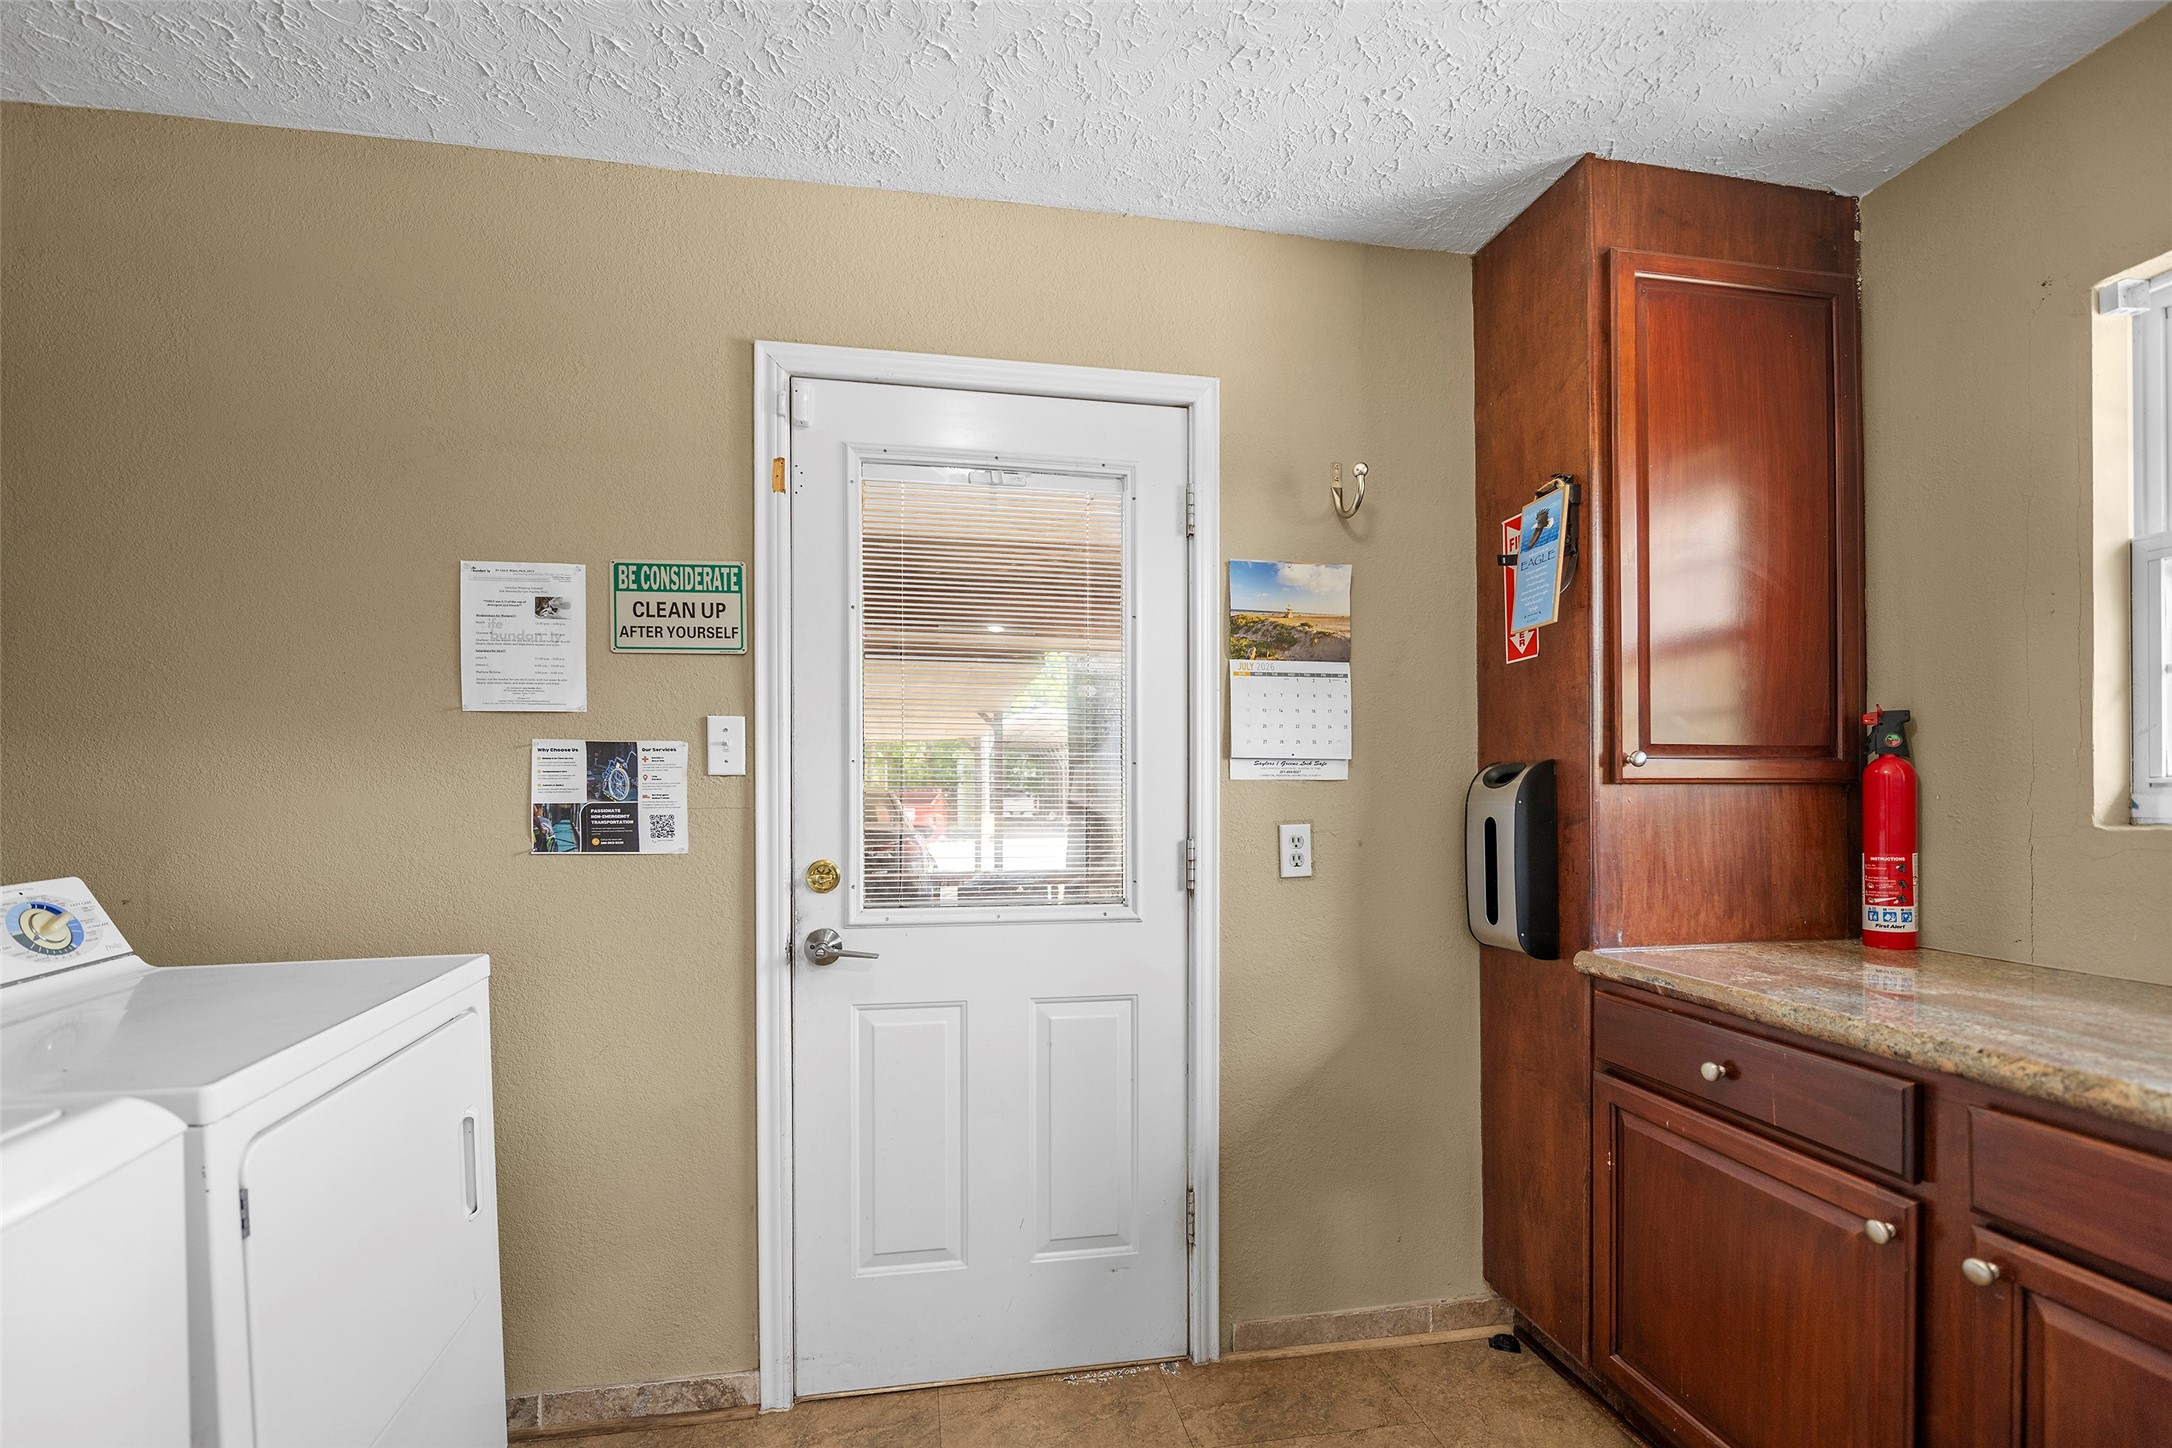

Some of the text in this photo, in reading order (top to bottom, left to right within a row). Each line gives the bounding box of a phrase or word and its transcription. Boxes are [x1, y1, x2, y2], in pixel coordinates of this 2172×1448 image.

[1510, 534, 1520, 552] FI
[1520, 550, 1555, 571] EAGLE
[618, 565, 739, 591] BE CONSIDERATE
[632, 601, 726, 618] CLEAN UP
[620, 626, 738, 639] AFTER YOURSELF
[1238, 662, 1275, 671] JULY 2026
